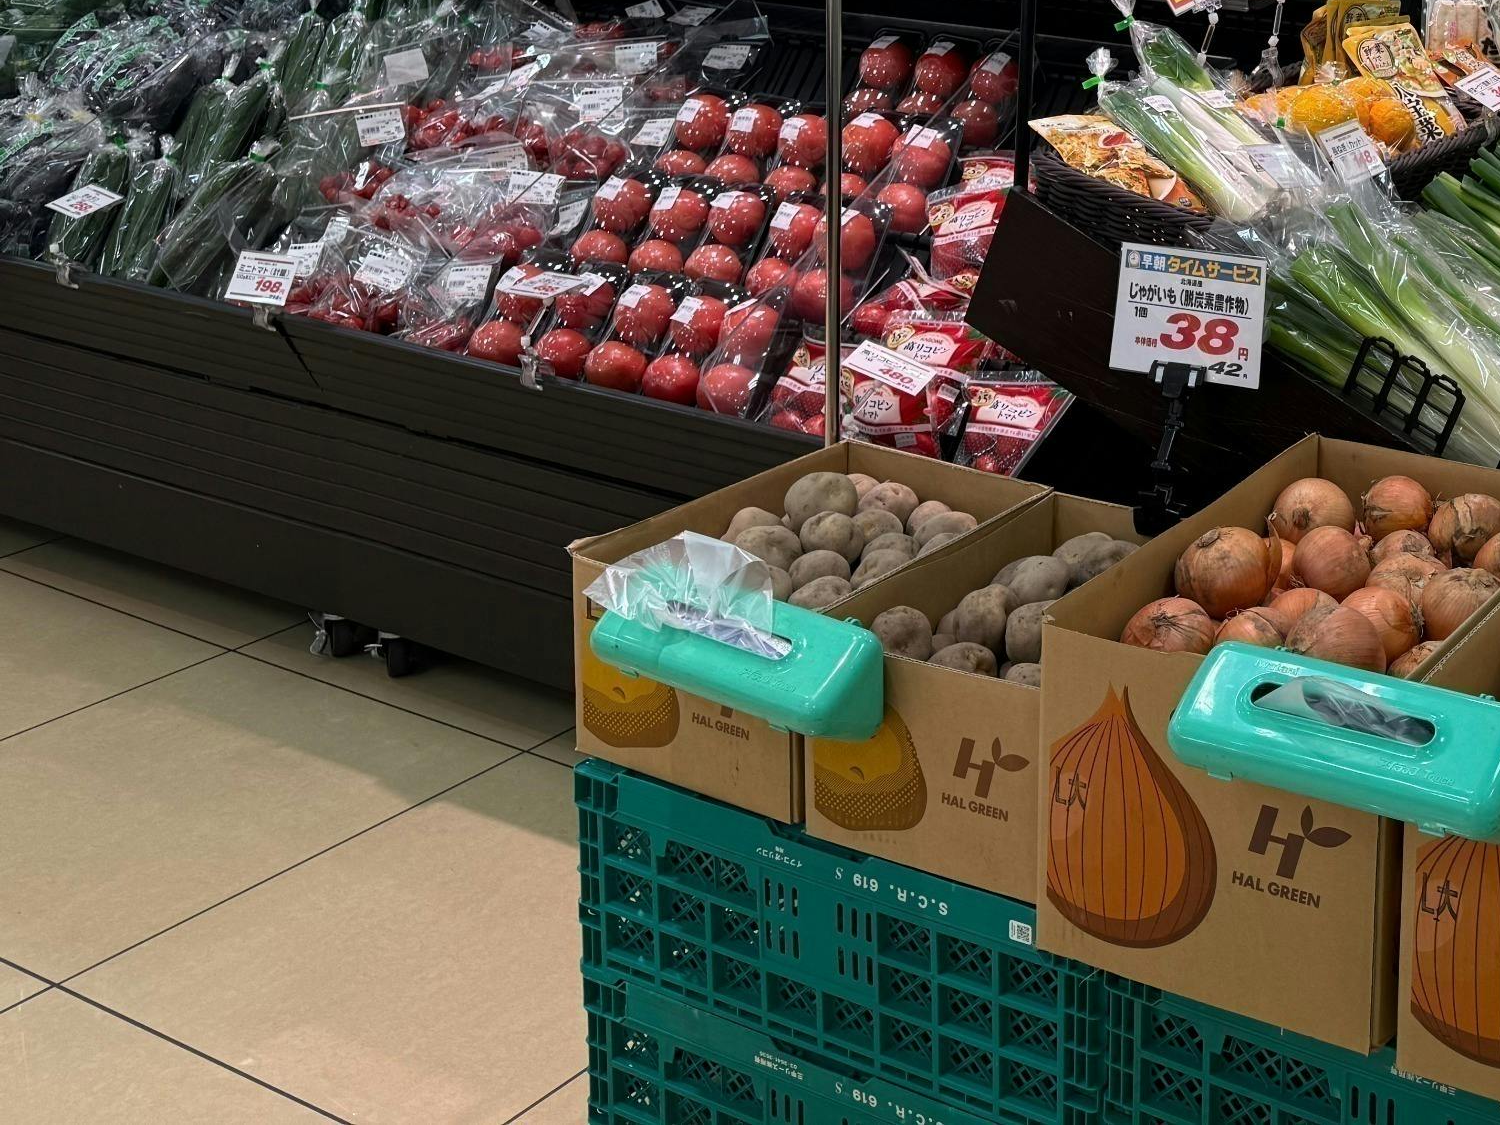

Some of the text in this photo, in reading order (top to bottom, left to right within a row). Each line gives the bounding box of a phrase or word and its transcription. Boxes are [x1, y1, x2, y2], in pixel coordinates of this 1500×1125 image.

[691, 711, 750, 742] HAL GREEN
[941, 792, 1009, 823] HAL GREEN
[853, 873, 879, 893] 619
[1231, 870, 1321, 909] HAL GREEN
